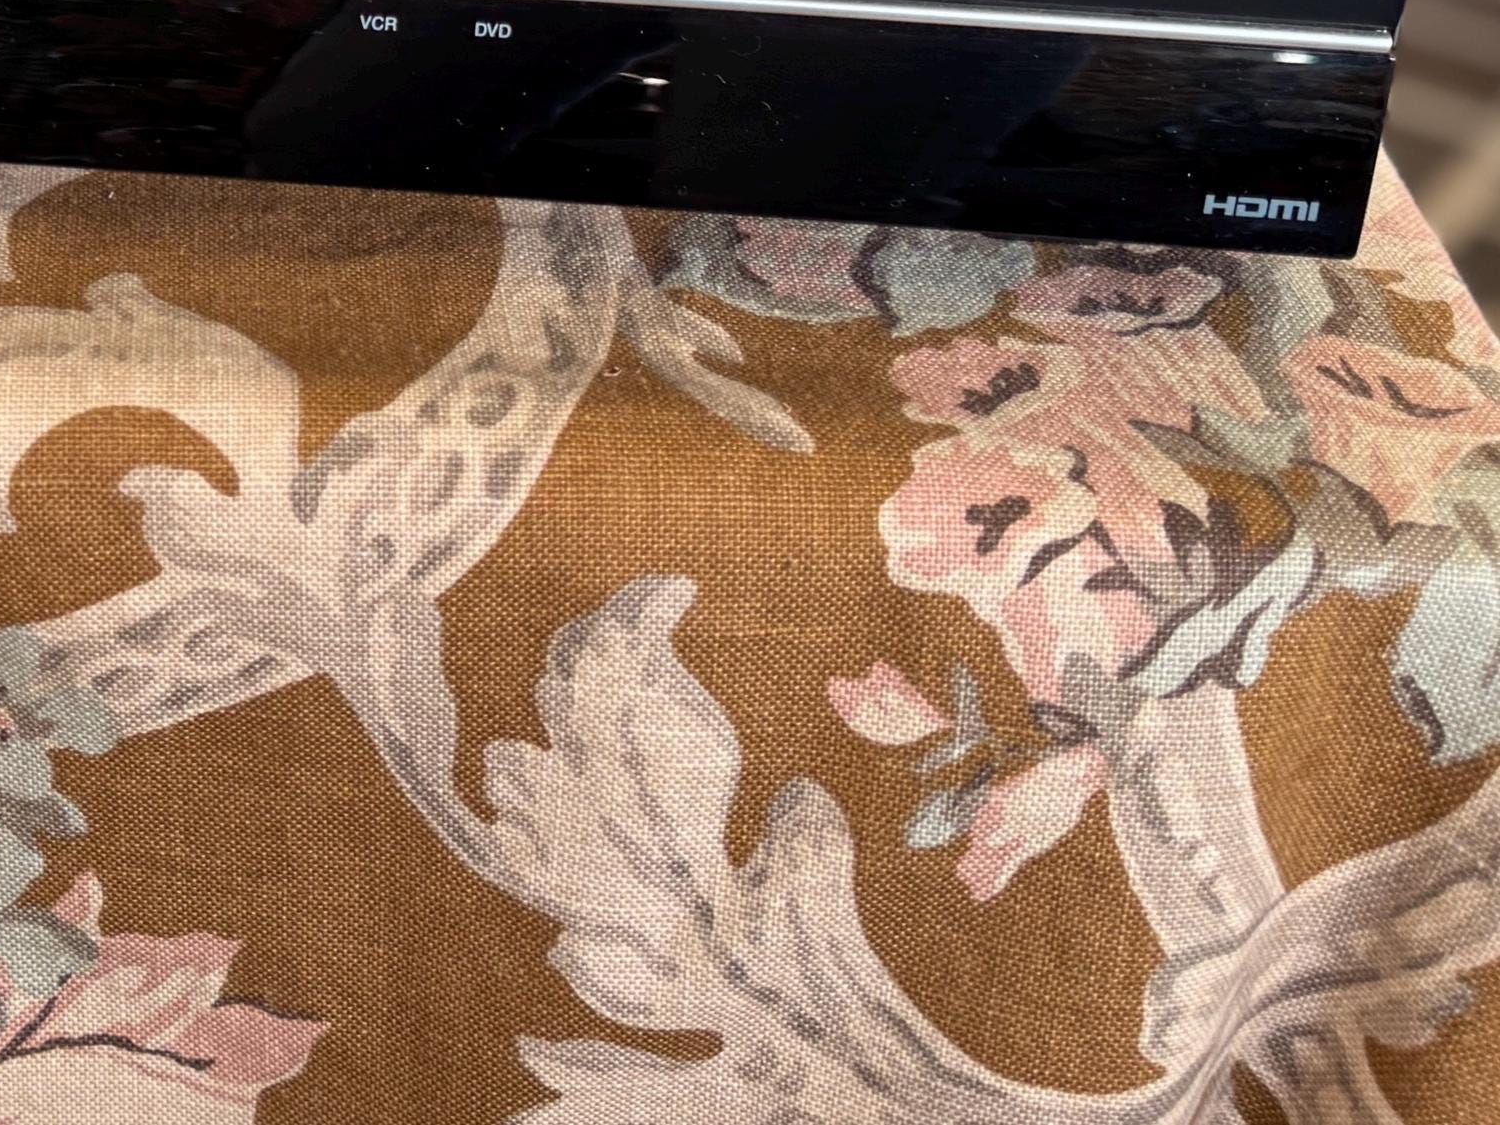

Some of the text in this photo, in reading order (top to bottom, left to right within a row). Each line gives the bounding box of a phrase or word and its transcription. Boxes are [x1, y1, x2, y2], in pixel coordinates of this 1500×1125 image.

[359, 14, 398, 32] VCR
[474, 21, 512, 39] DVD
[1203, 194, 1320, 222] HDMI
